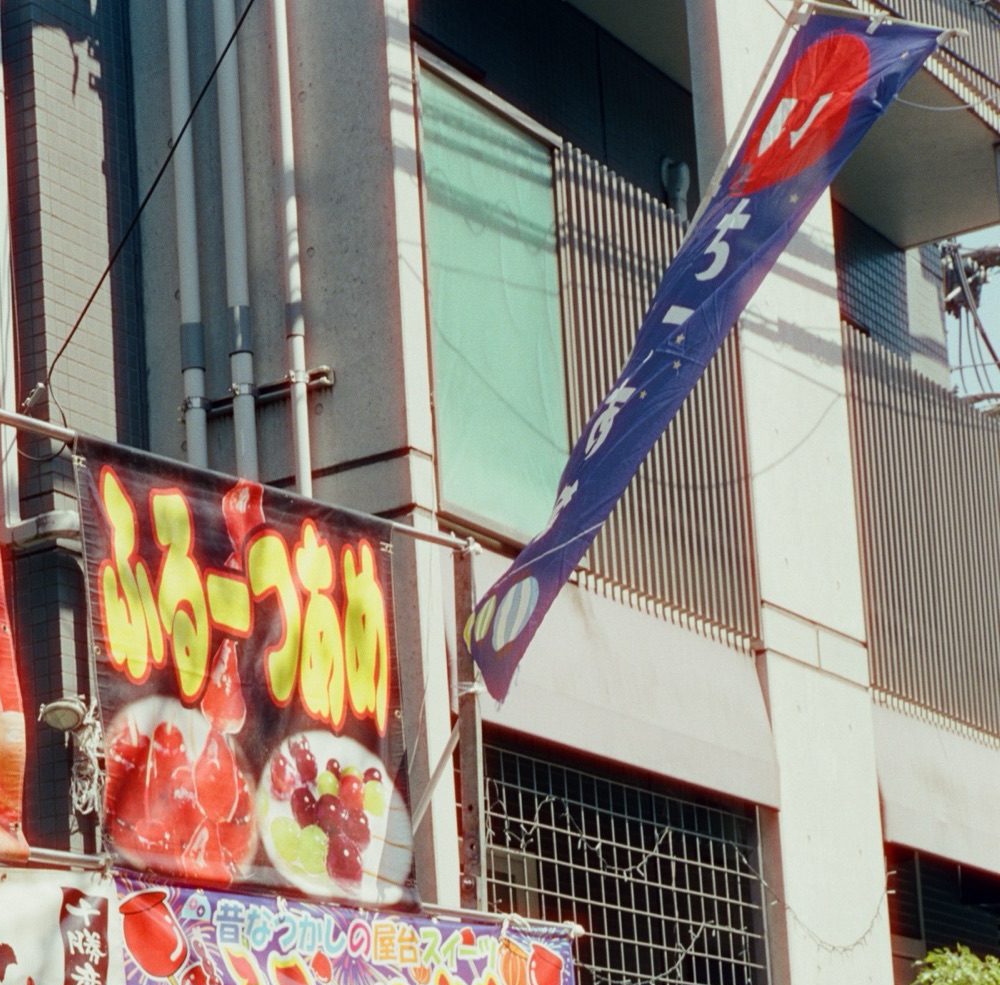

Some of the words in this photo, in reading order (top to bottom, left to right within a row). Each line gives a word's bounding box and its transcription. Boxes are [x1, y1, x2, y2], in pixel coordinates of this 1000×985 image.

[101, 463, 390, 738] ふるーつあめ
[214, 898, 500, 971] 昔なつかしの屋台スイーツ
